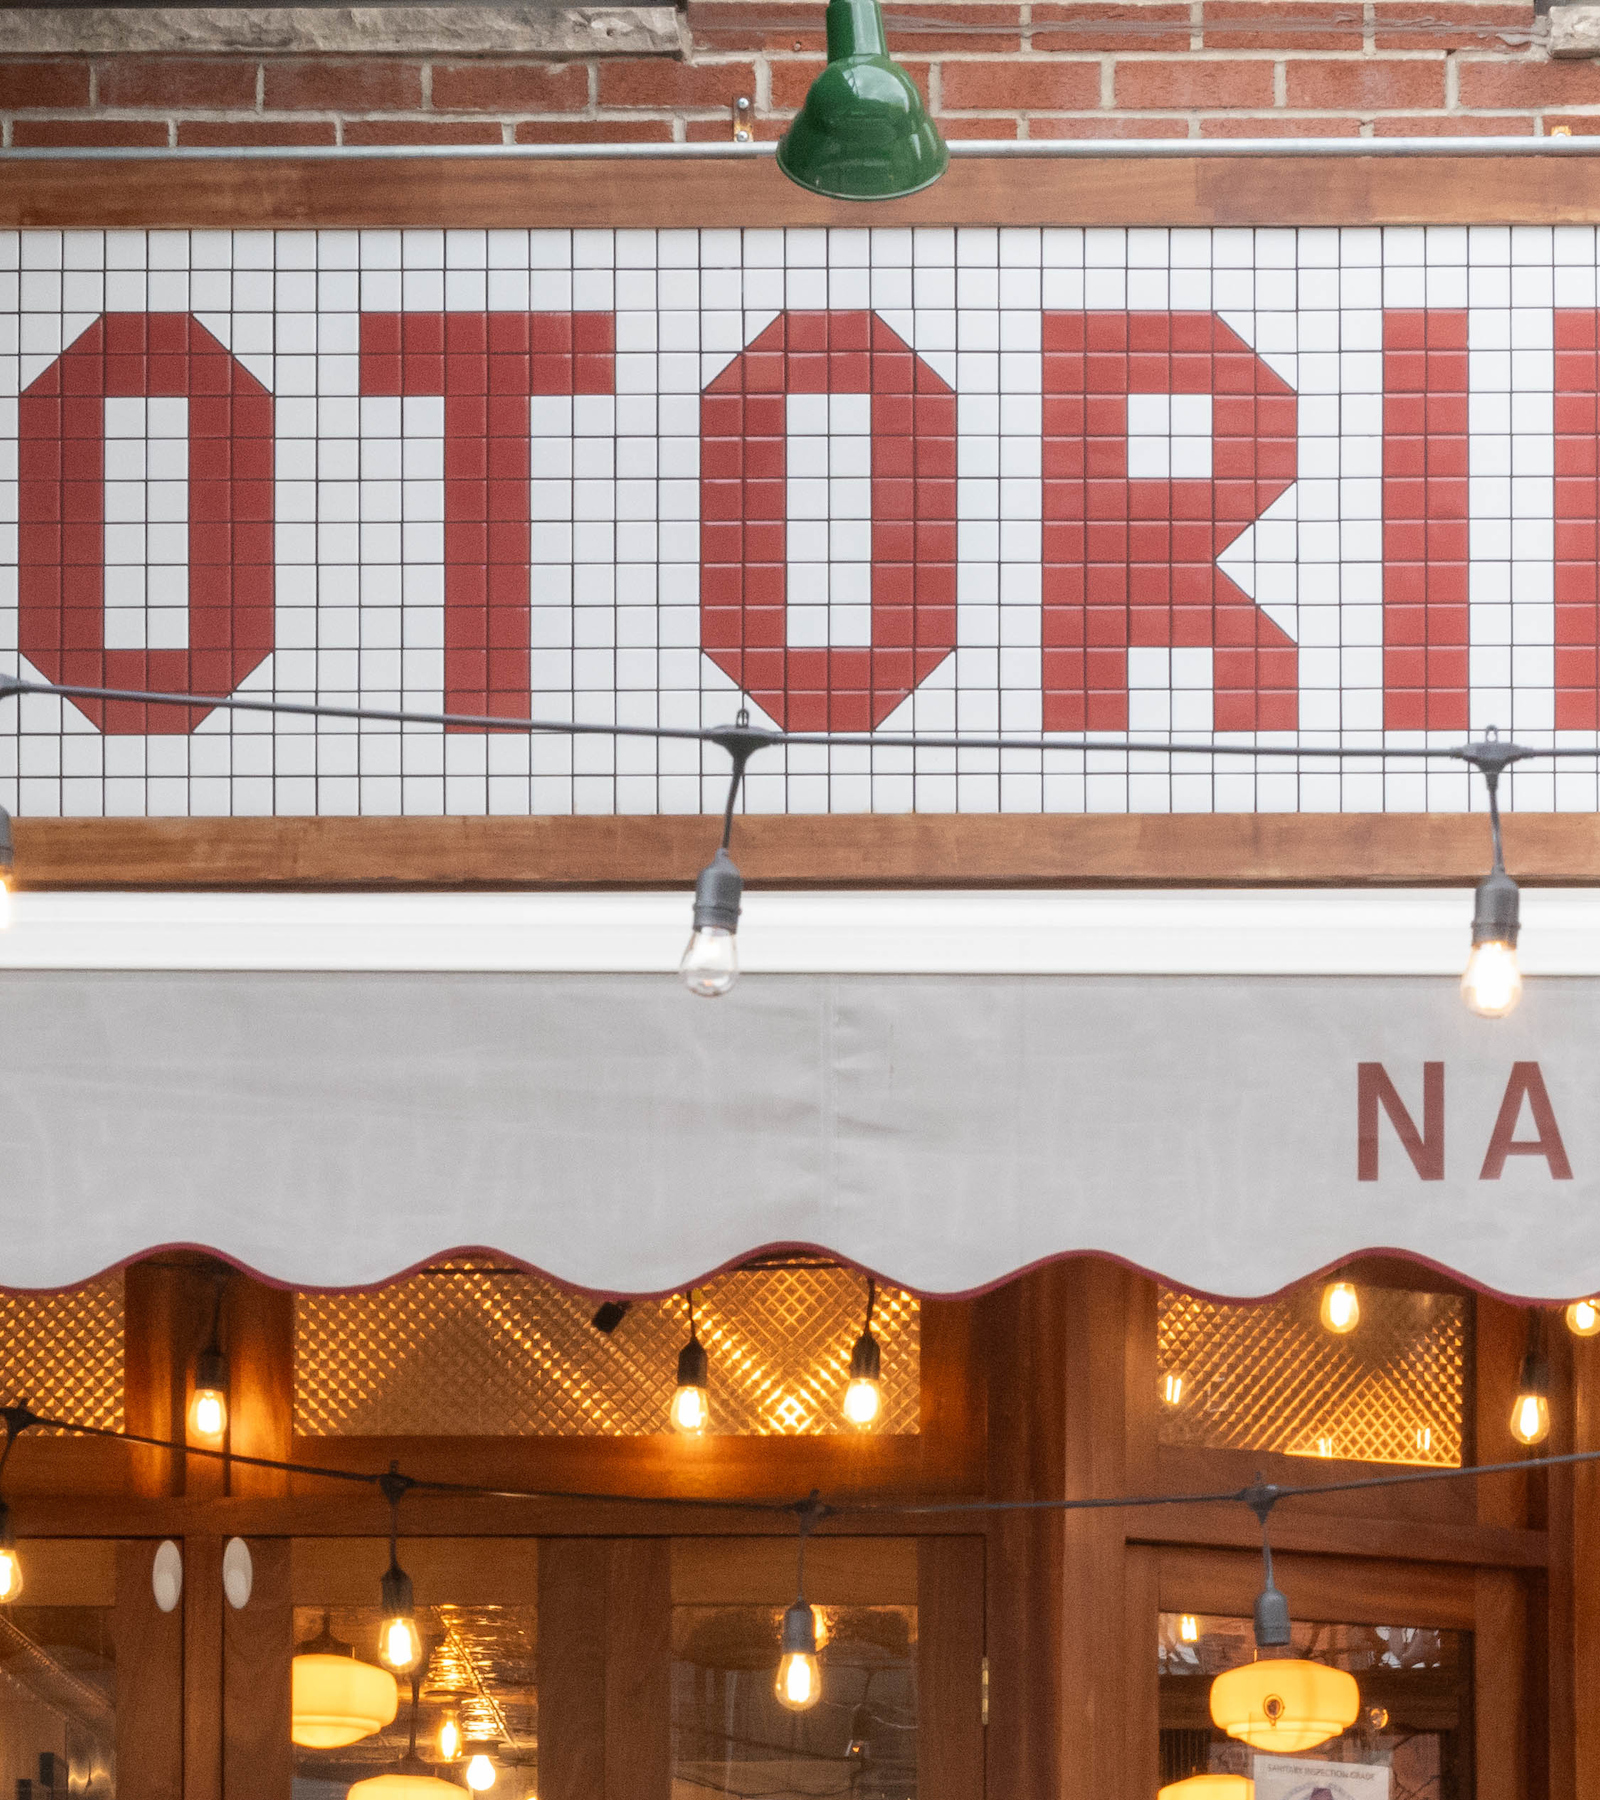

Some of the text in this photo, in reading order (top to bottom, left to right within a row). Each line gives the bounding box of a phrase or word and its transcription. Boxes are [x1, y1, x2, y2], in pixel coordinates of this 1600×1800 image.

[1267, 1764, 1375, 1781] SANITARY INSPECTION GRADE
